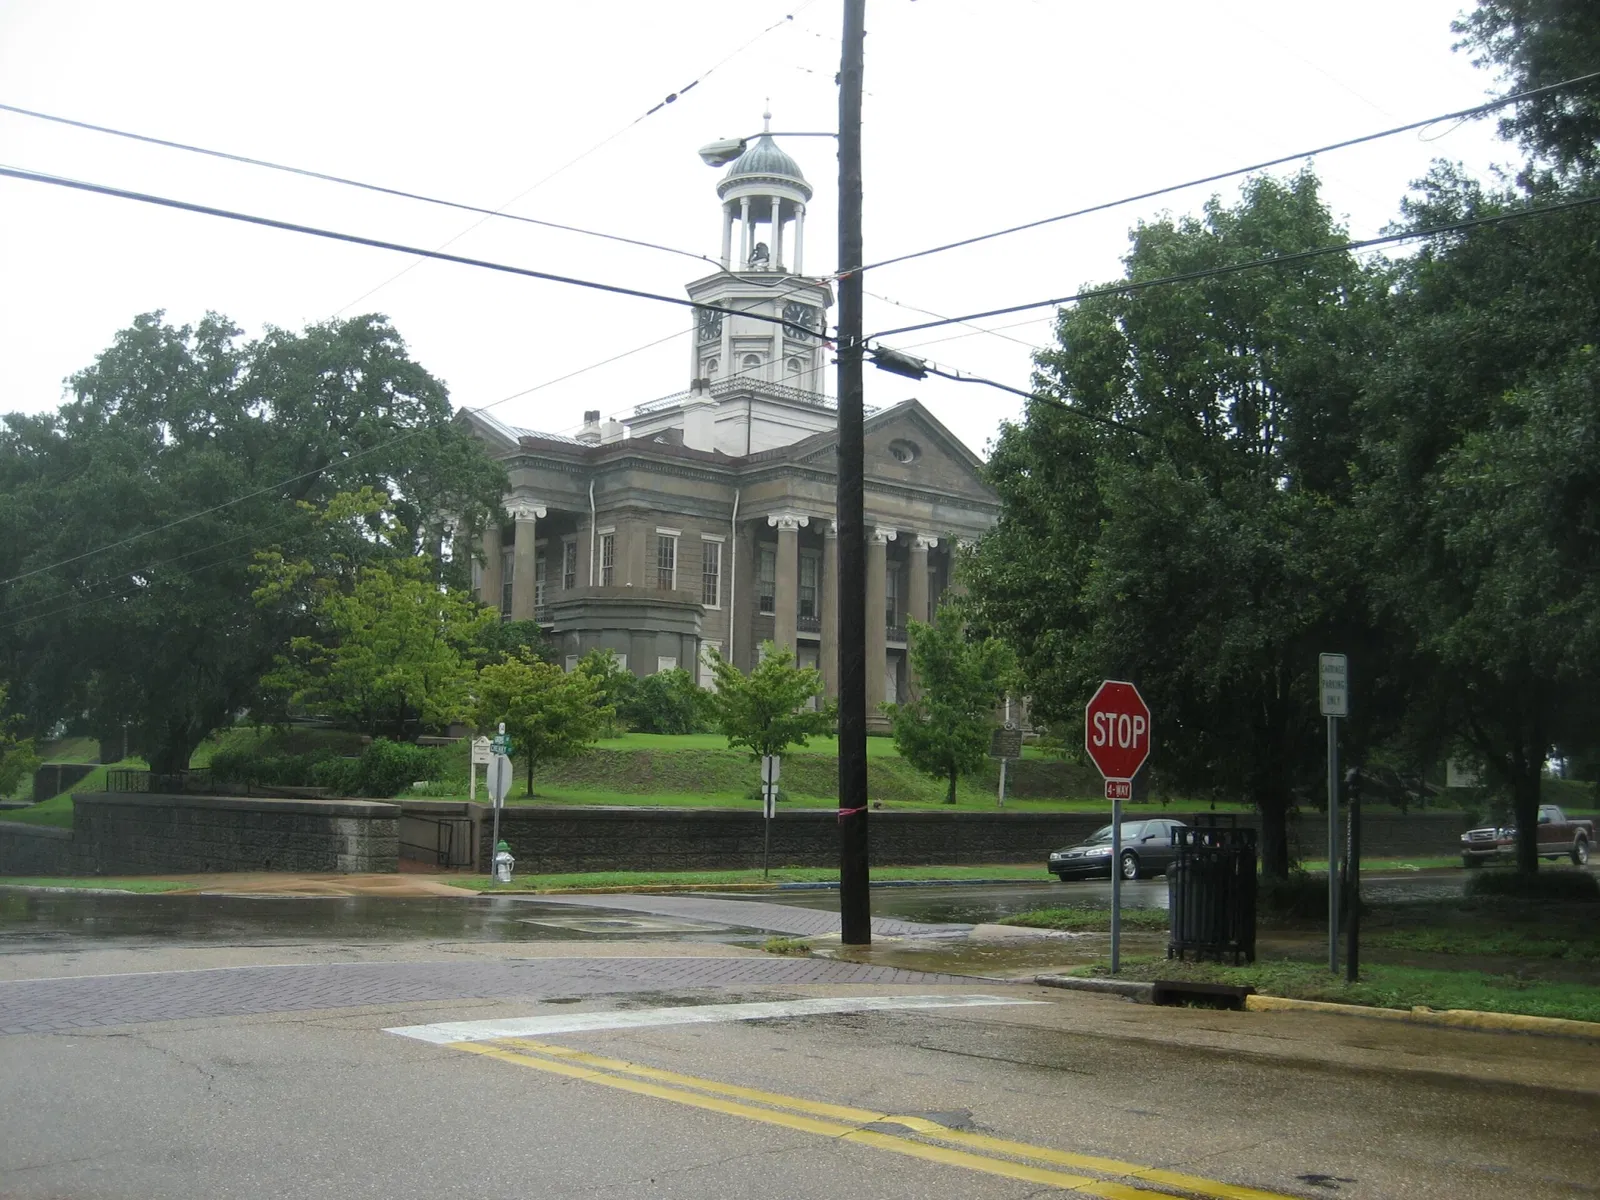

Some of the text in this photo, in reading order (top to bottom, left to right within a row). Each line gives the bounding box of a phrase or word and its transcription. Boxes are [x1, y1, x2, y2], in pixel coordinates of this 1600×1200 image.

[1322, 680, 1345, 689] PARKING
[1327, 695, 1341, 705] ONLY
[1093, 712, 1145, 748] STOP
